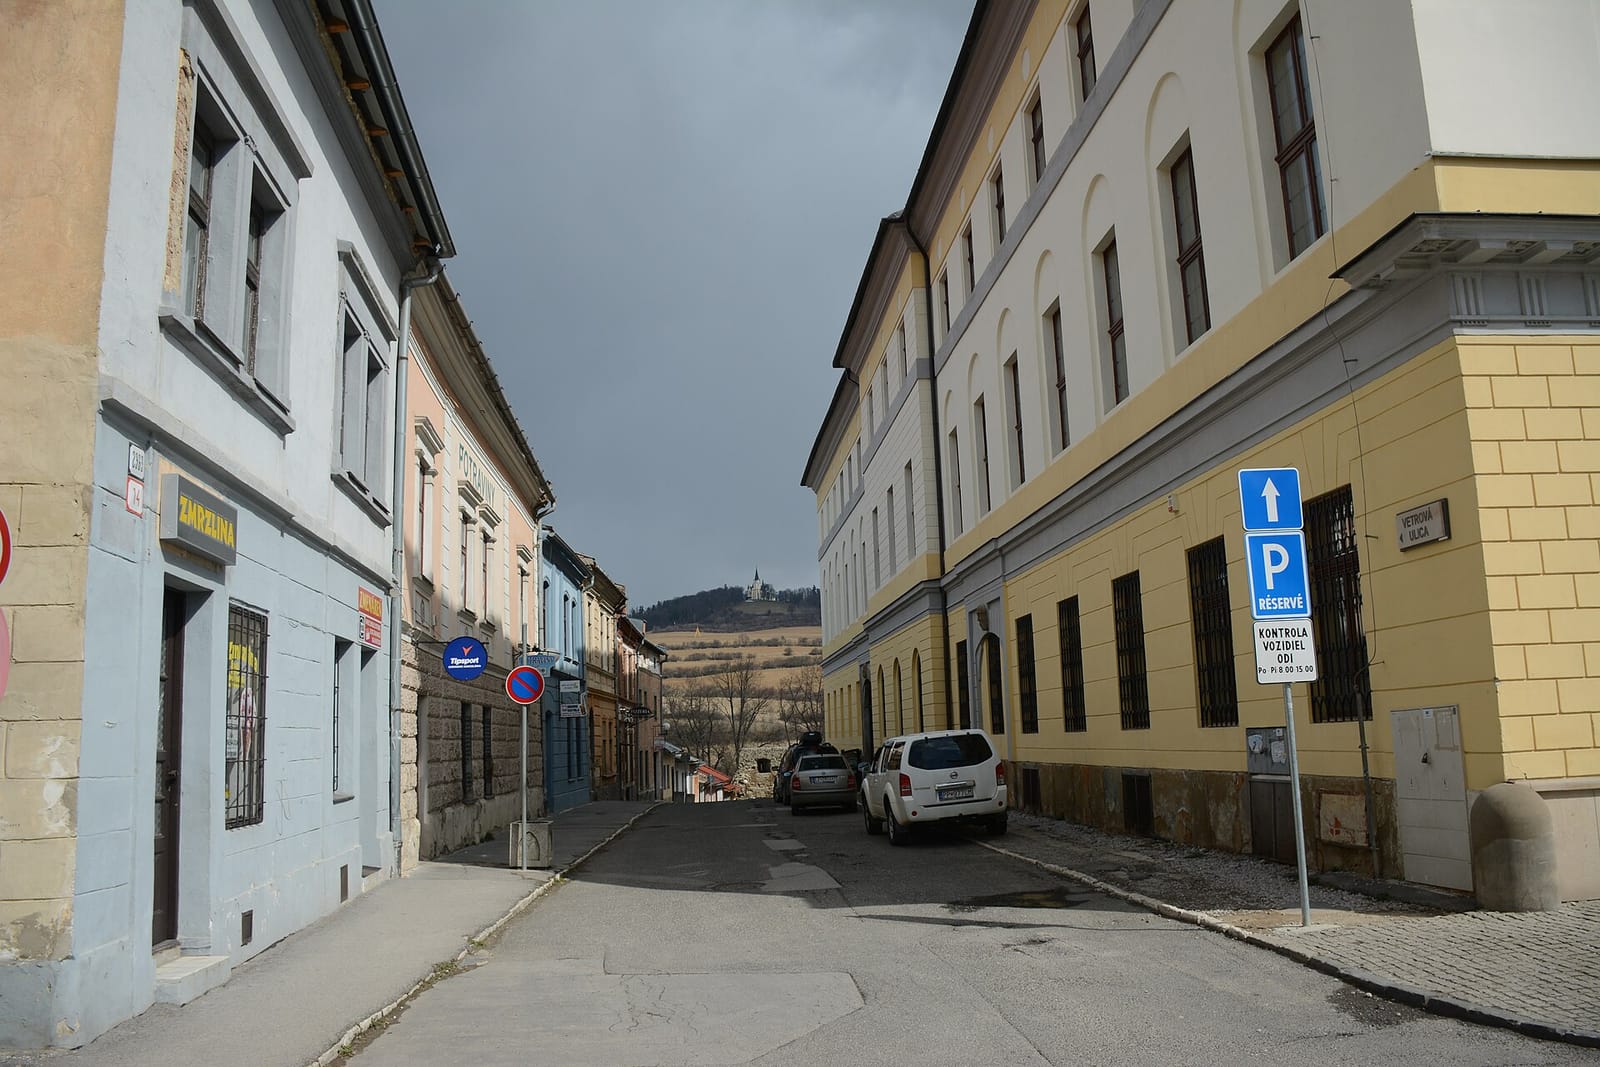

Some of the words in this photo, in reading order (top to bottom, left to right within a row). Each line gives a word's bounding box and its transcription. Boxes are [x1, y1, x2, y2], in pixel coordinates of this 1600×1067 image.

[459, 442, 496, 508] POTRAVINY
[179, 494, 235, 550] ZMRZLINA
[1401, 506, 1433, 529] VETROVÁ
[1408, 525, 1430, 541] ULICA
[1262, 543, 1289, 590] P
[1258, 593, 1304, 611] RÉSERVÉ
[1258, 627, 1309, 639] KONTROLA
[1262, 640, 1306, 652] VOZIDIEL
[450, 657, 480, 666] Tipsport
[1277, 653, 1294, 664] ODI
